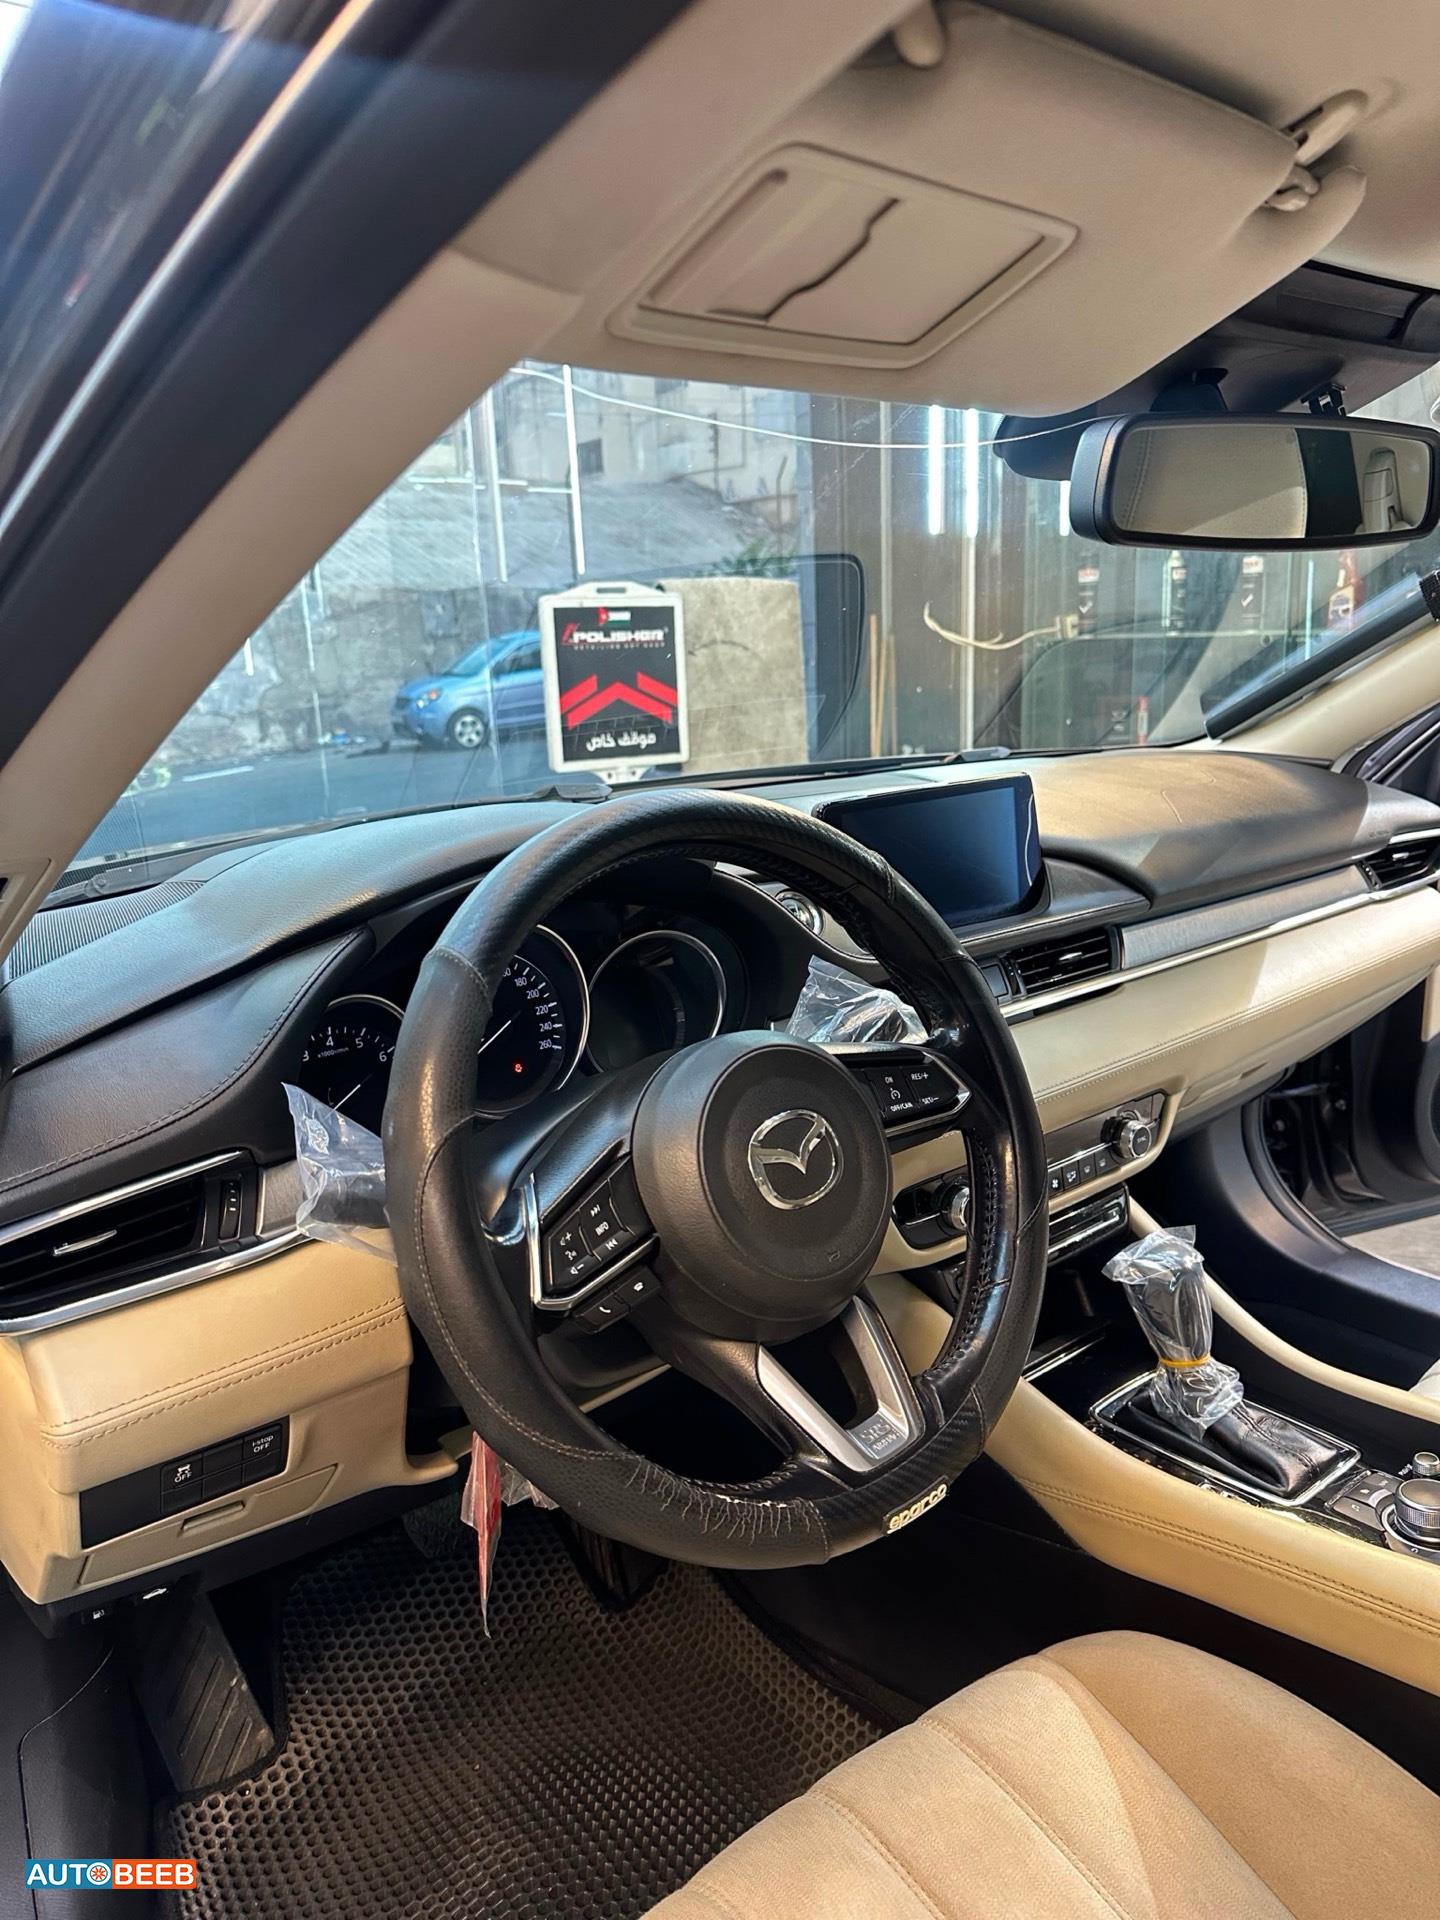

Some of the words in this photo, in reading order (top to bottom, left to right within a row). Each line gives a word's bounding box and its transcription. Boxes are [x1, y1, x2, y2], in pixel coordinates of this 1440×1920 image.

[586, 732, 616, 752] خاص
[618, 731, 656, 749] موقف
[514, 977, 527, 987] 180
[526, 989, 539, 999] 200
[535, 1005, 549, 1015] 220
[539, 1021, 553, 1032] 240
[326, 1036, 334, 1046] 4
[355, 1037, 364, 1048] 5
[539, 1039, 552, 1050] 260
[302, 1050, 310, 1062] 3
[379, 1051, 387, 1062] 6
[252, 1435, 274, 1447] i-stop
[253, 1442, 270, 1453] OFF
[174, 1472, 192, 1483] OFF
